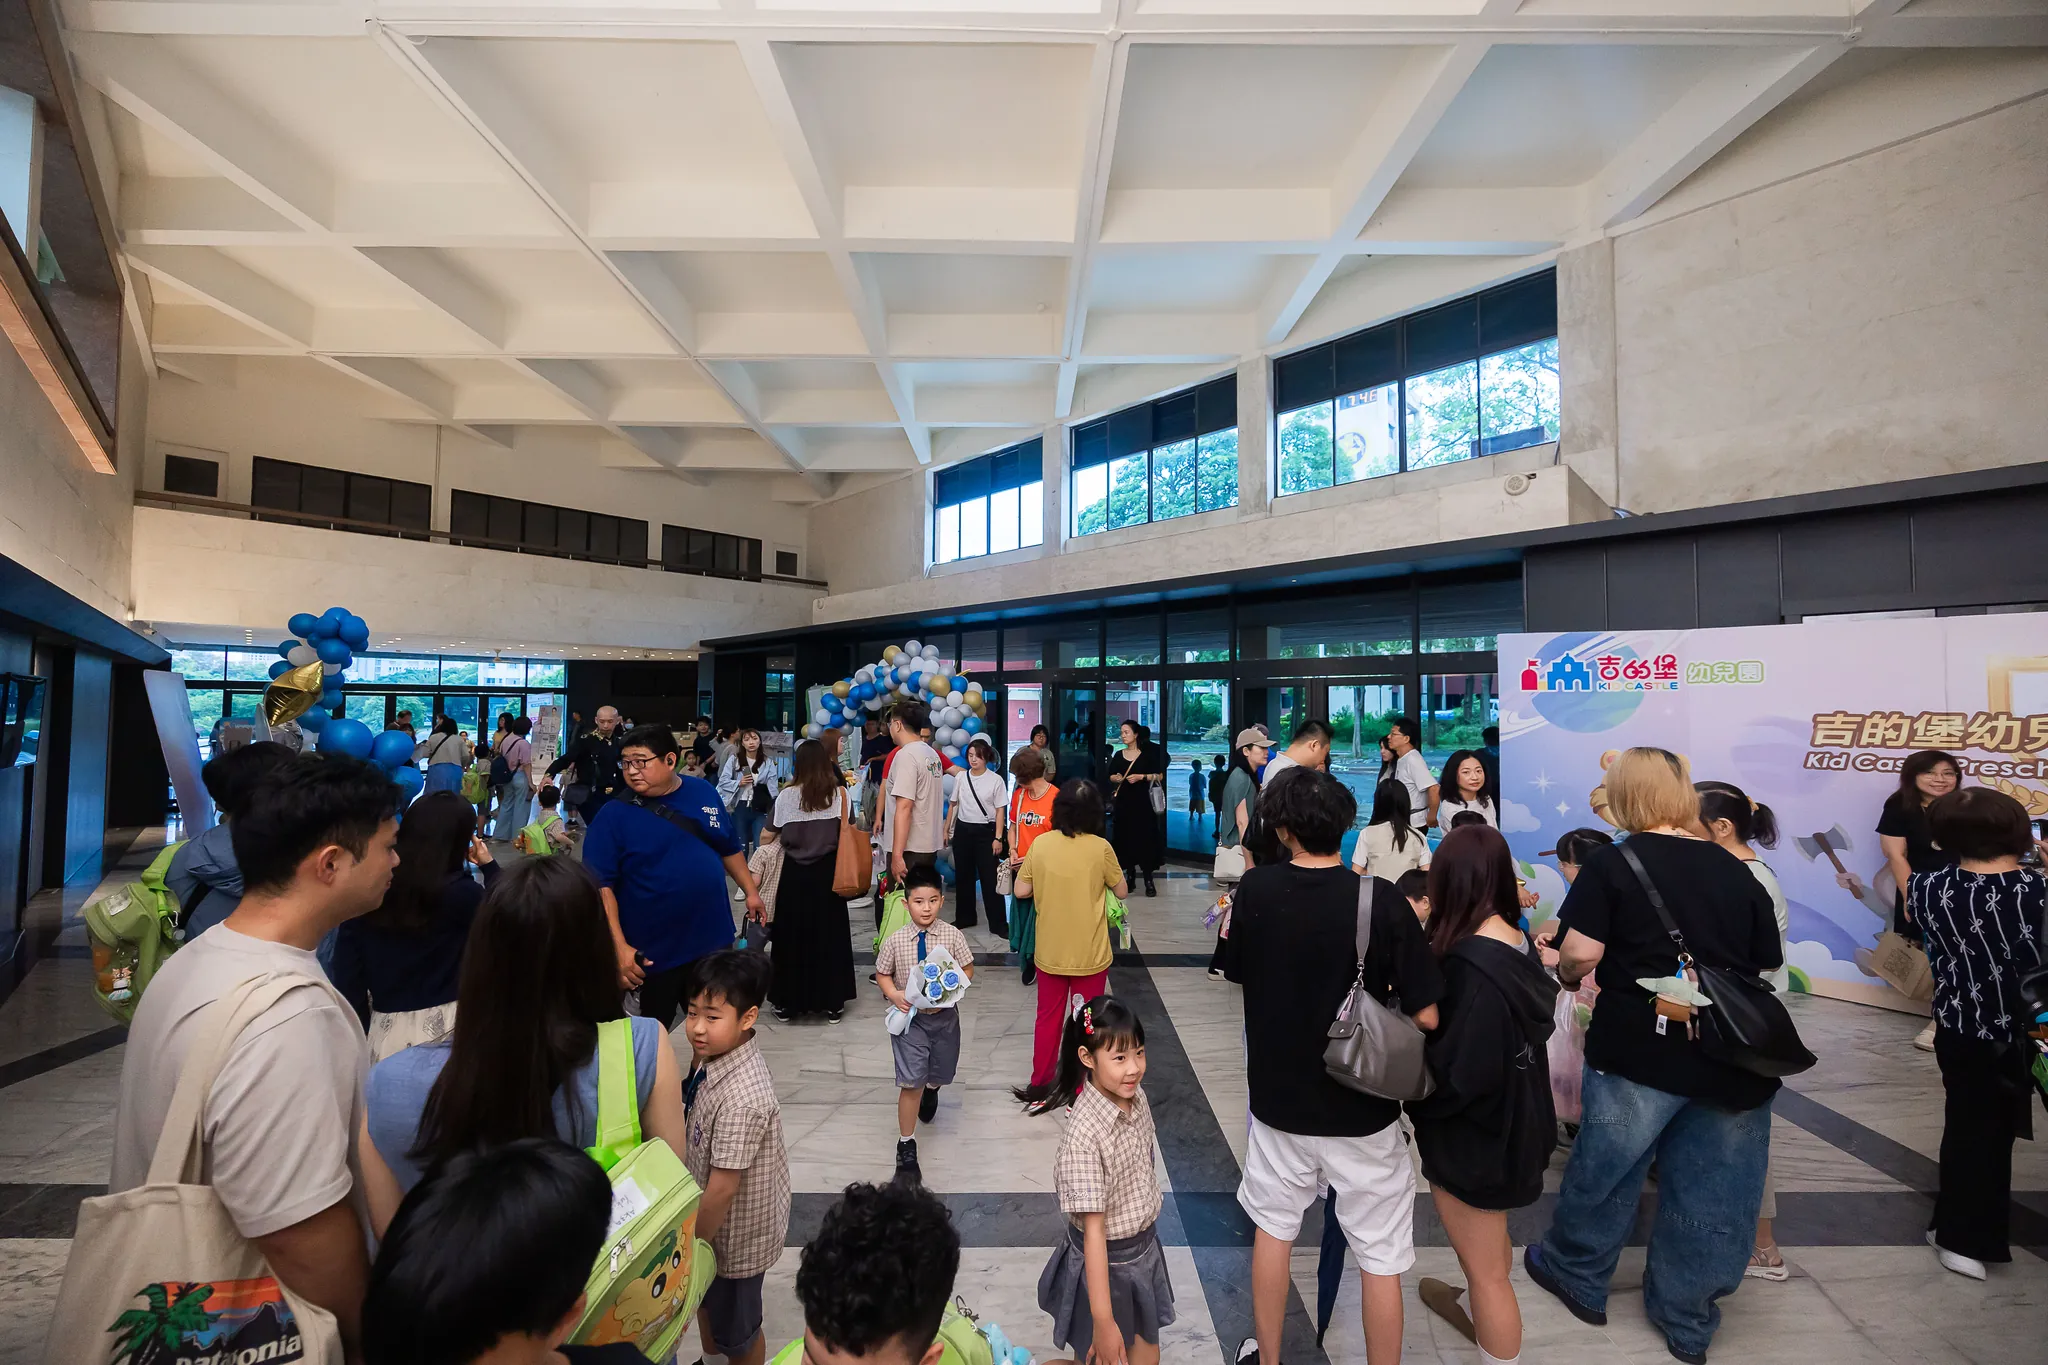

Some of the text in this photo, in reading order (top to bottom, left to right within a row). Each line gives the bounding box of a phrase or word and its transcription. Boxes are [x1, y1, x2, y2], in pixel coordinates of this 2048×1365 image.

[1597, 654, 1764, 684] 吉的堡 幼兒園
[1599, 682, 1678, 690] KID CASTLE
[1806, 753, 1848, 769] Kid
[1855, 755, 1905, 771] Cas
